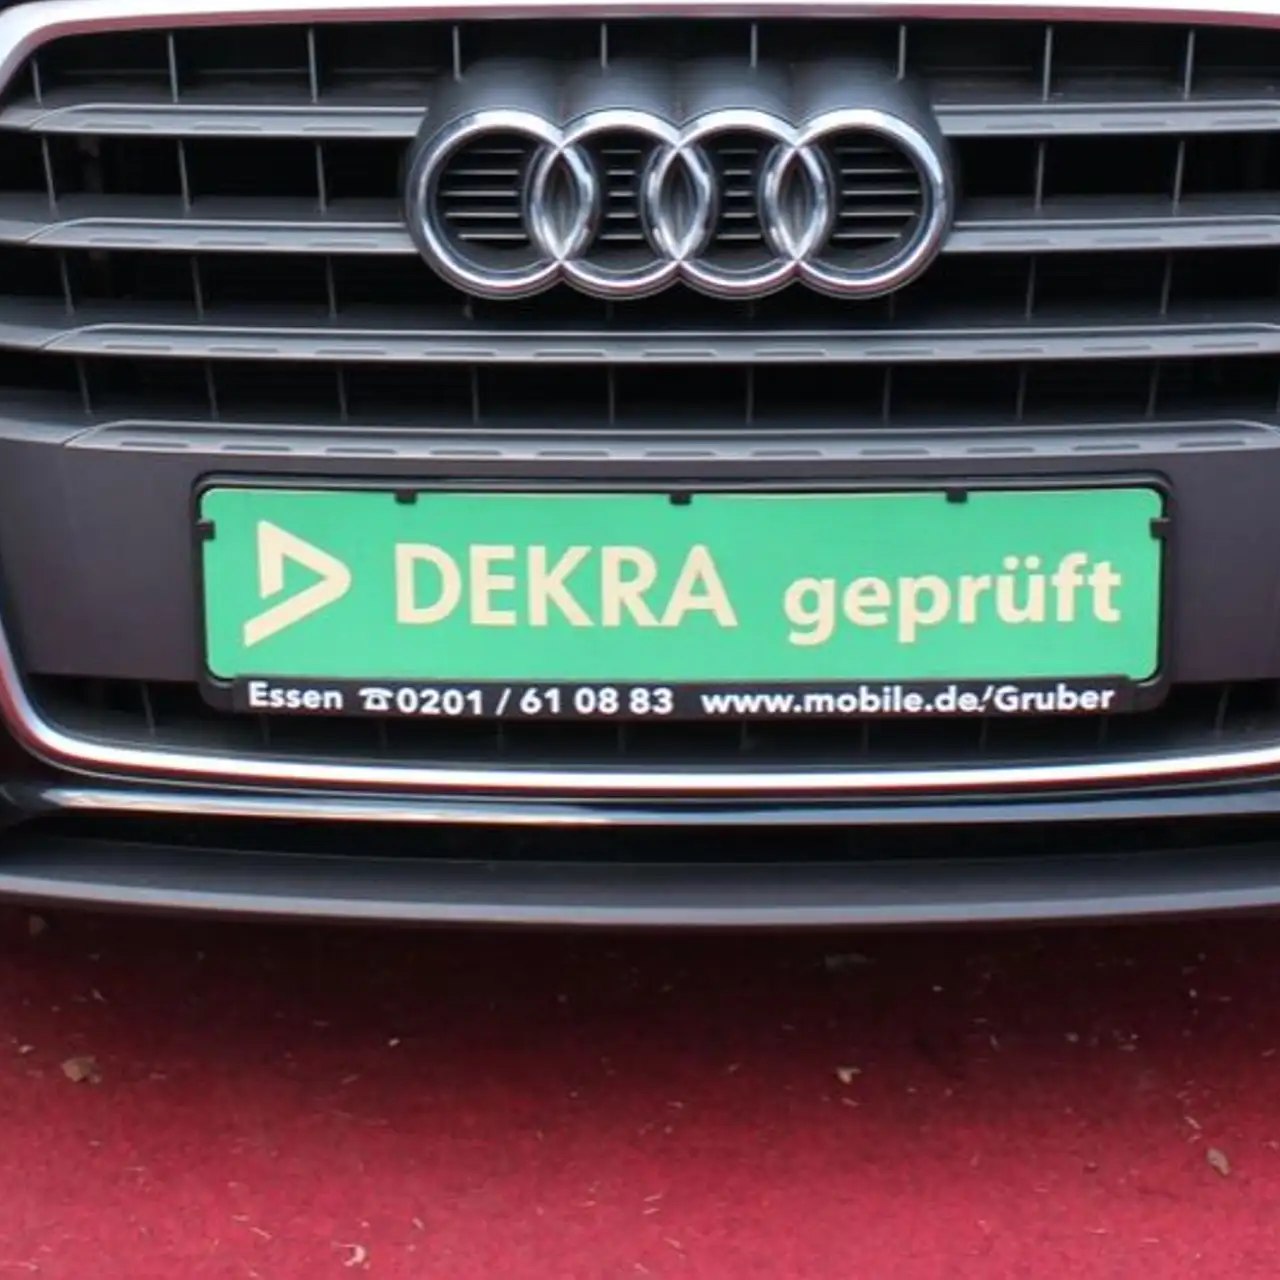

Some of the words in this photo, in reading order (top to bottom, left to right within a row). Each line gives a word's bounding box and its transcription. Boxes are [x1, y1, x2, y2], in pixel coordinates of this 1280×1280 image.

[394, 542, 737, 628] DEKRA
[781, 550, 1122, 645] geprüft
[248, 681, 343, 710] Essen
[396, 686, 483, 716] 0201
[519, 687, 560, 714] 61
[574, 686, 619, 714] 08
[629, 686, 675, 714] 83
[700, 682, 1115, 713] www.mobile.de/Gruber
